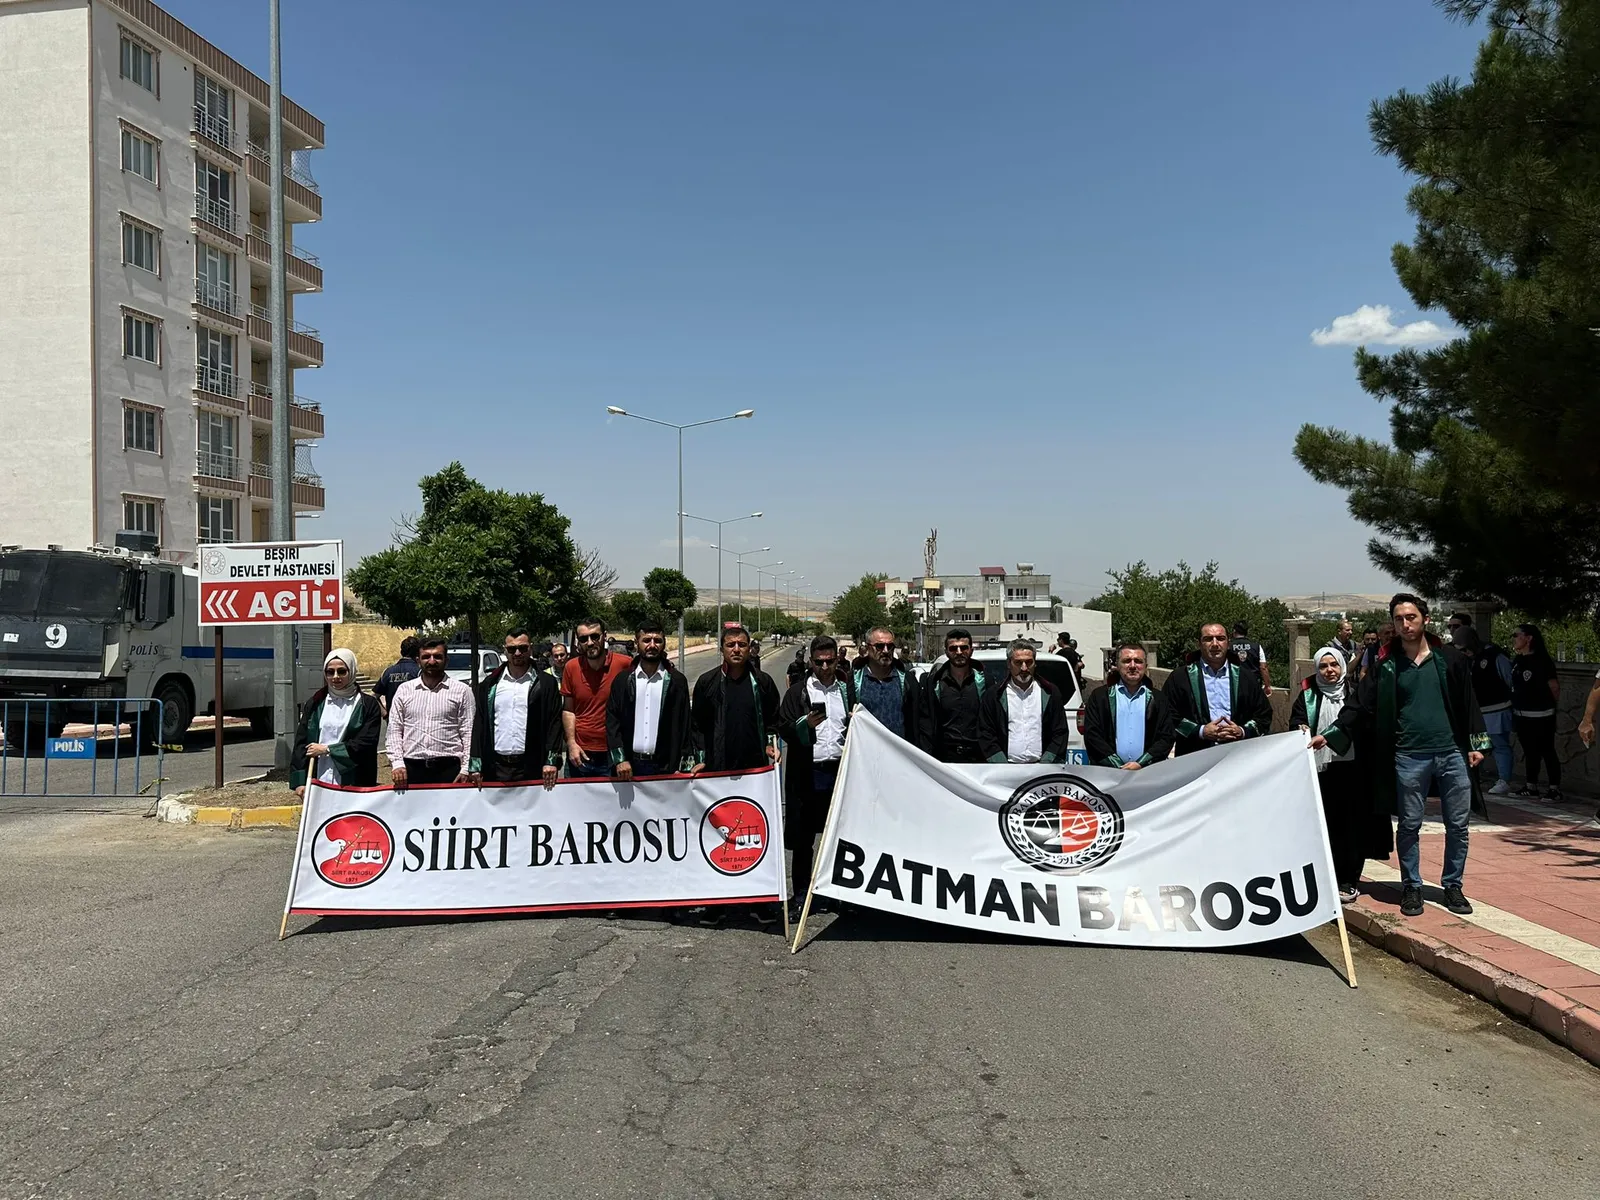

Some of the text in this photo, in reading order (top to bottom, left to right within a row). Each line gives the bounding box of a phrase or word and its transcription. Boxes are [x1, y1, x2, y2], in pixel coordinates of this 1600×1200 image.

[230, 560, 335, 578] DEVLET HASTANESİ
[247, 583, 333, 618] ACİL
[45, 623, 68, 649] 9
[129, 641, 160, 656] POLİS
[389, 672, 410, 683] TEM
[54, 739, 85, 753] POLİS
[1012, 785, 1059, 817] BATMAN
[402, 816, 691, 873] SİİRT BAROSU
[831, 838, 1319, 932] BATMAN BAROSU
